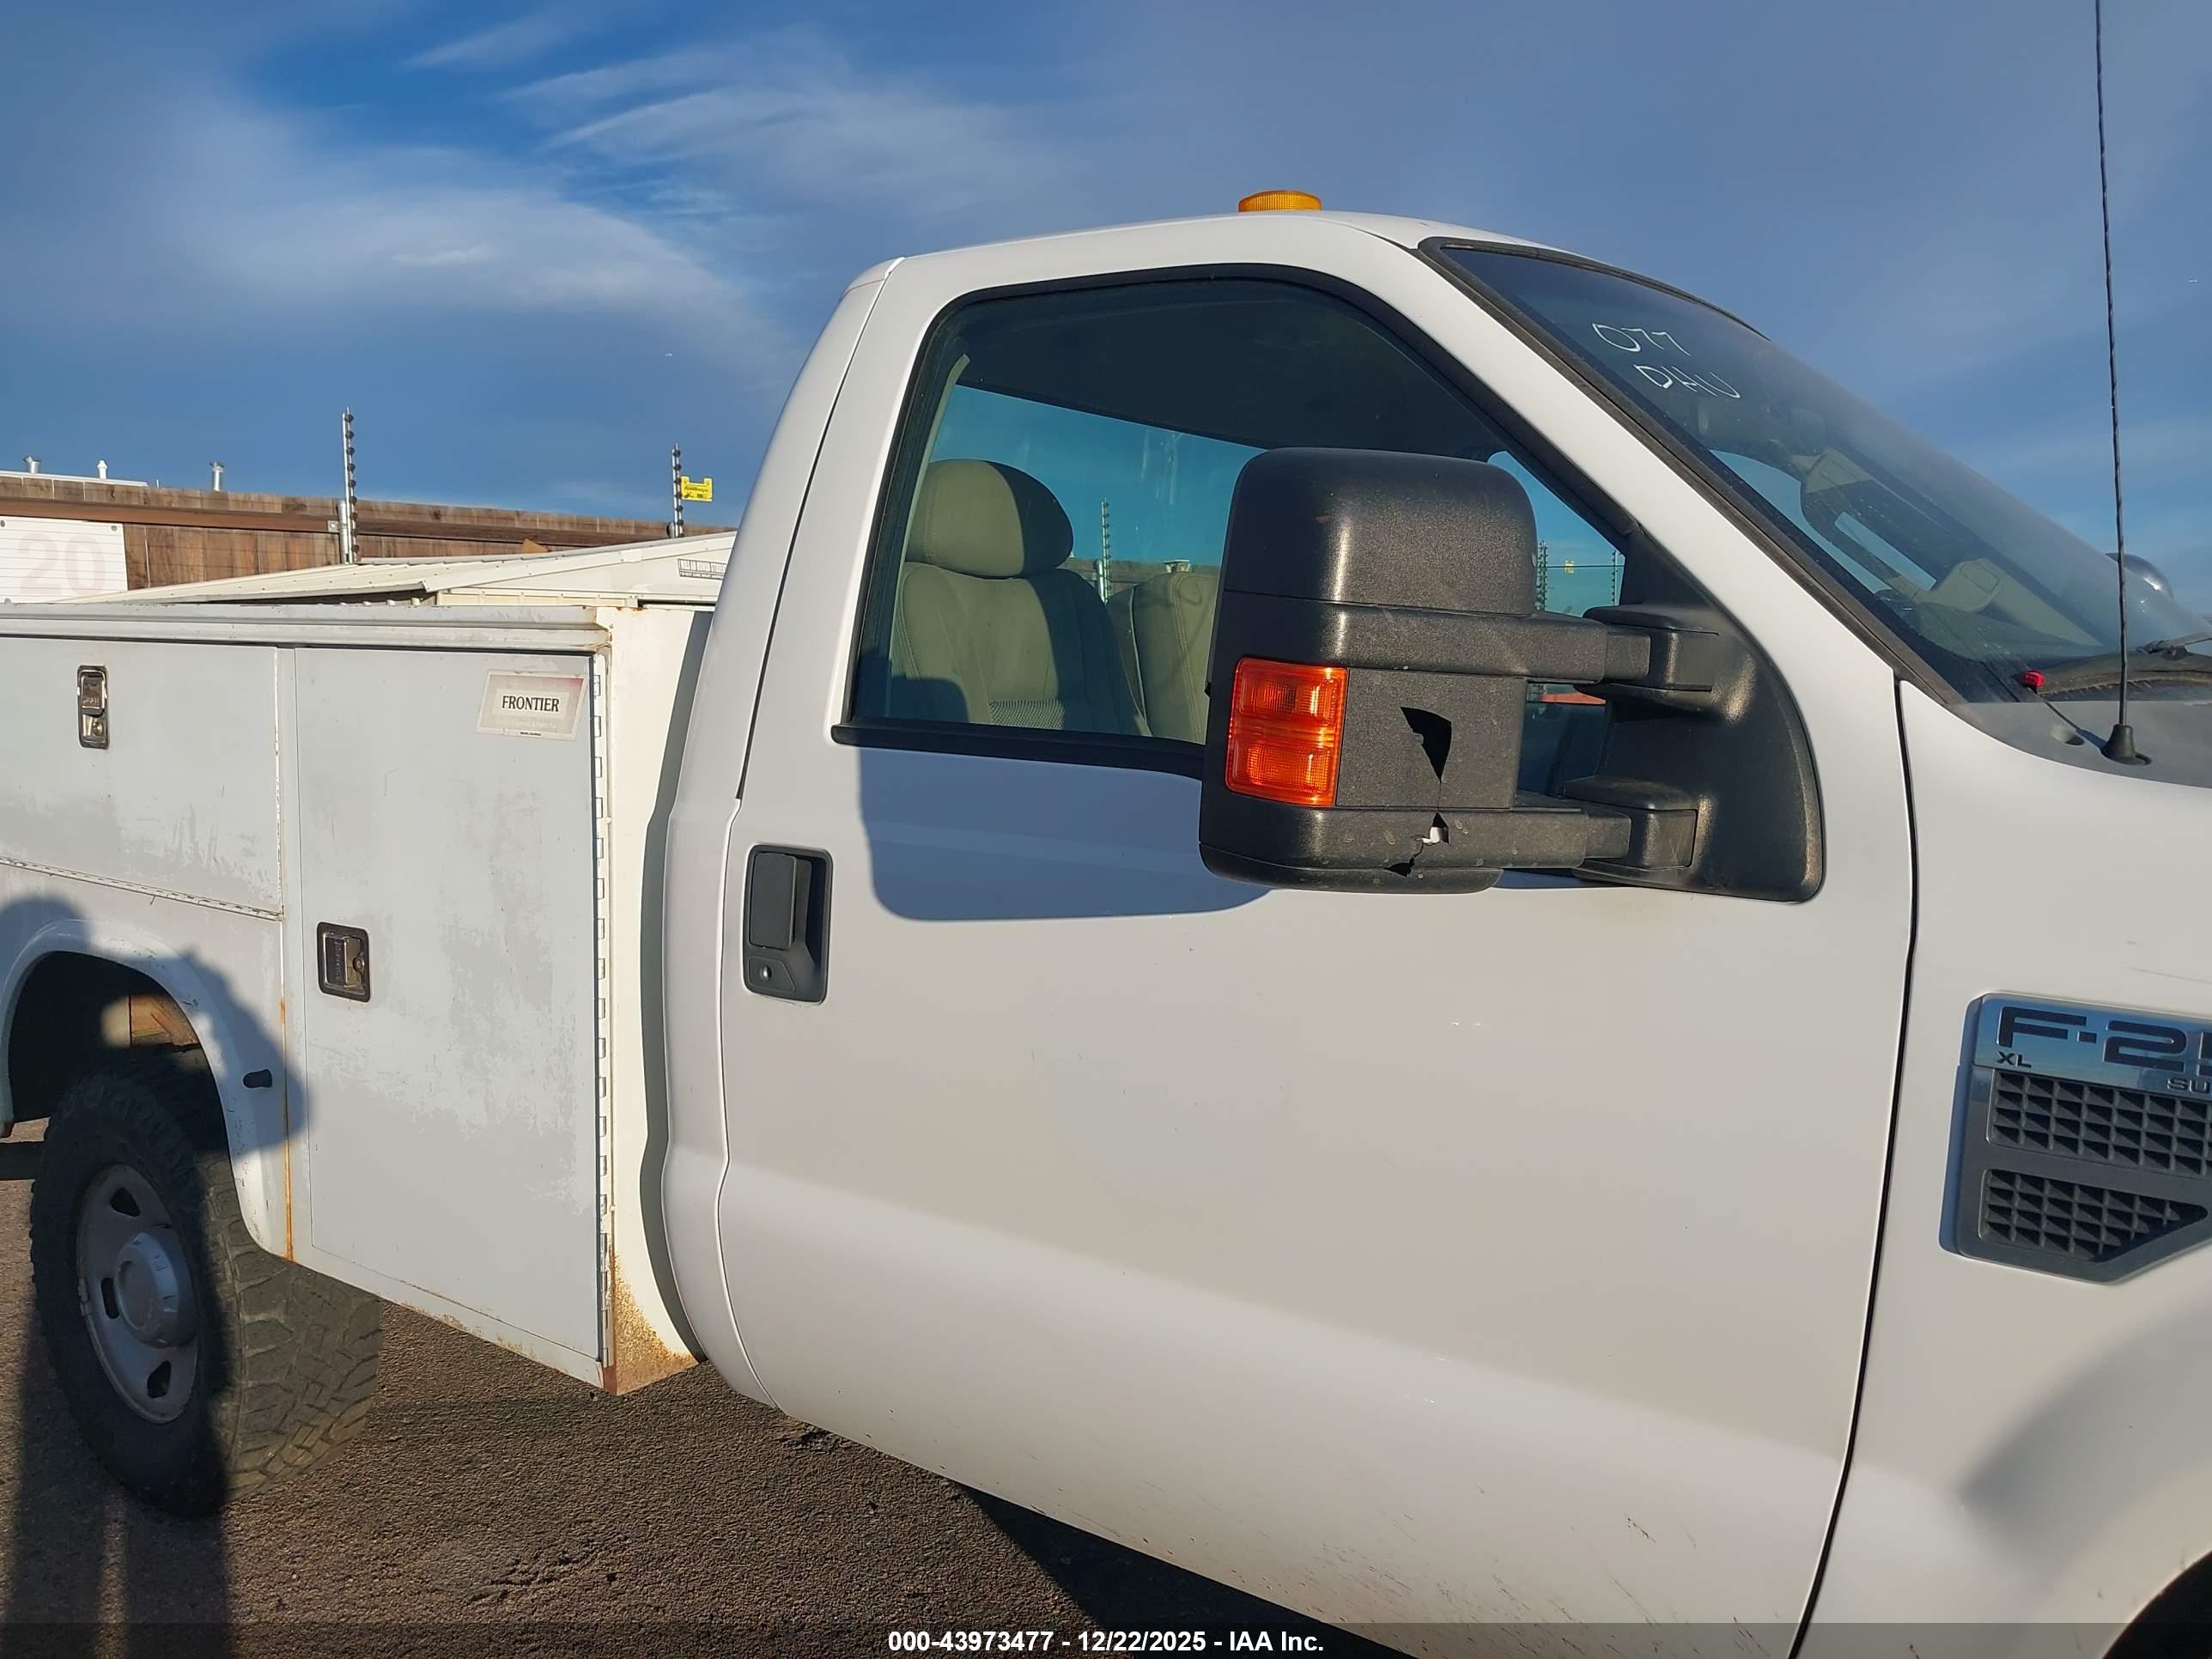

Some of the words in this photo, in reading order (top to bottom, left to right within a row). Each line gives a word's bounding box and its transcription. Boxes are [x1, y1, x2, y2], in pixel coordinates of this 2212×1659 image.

[15, 532, 106, 597] 20
[501, 695, 560, 713] FRONTIER
[1996, 1006, 2212, 1076] F-2
[1996, 1050, 2032, 1068] XL
